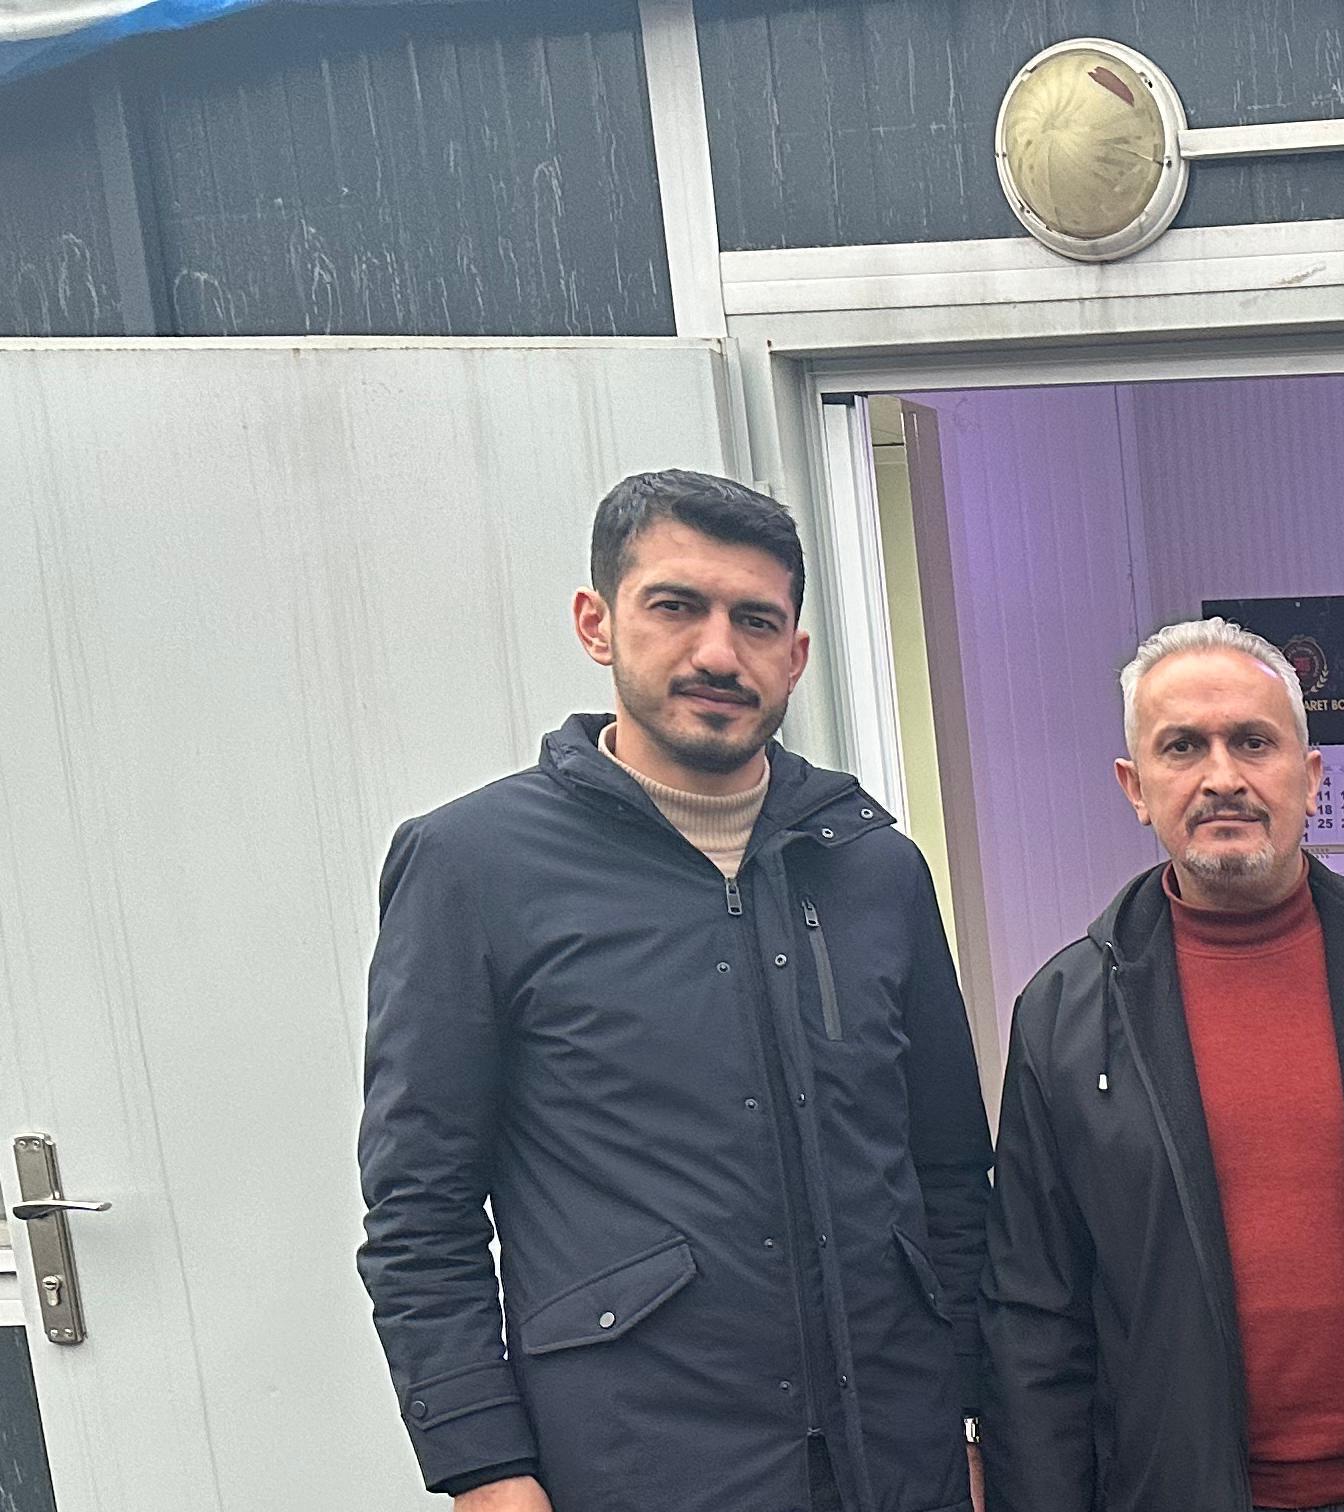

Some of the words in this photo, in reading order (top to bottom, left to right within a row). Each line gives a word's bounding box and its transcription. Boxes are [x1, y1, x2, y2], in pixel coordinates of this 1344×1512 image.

[1304, 700, 1328, 711] ARET
[1323, 777, 1331, 787] 4
[1317, 791, 1330, 801] 11
[1317, 805, 1332, 815] 18
[1318, 818, 1333, 828] 25
